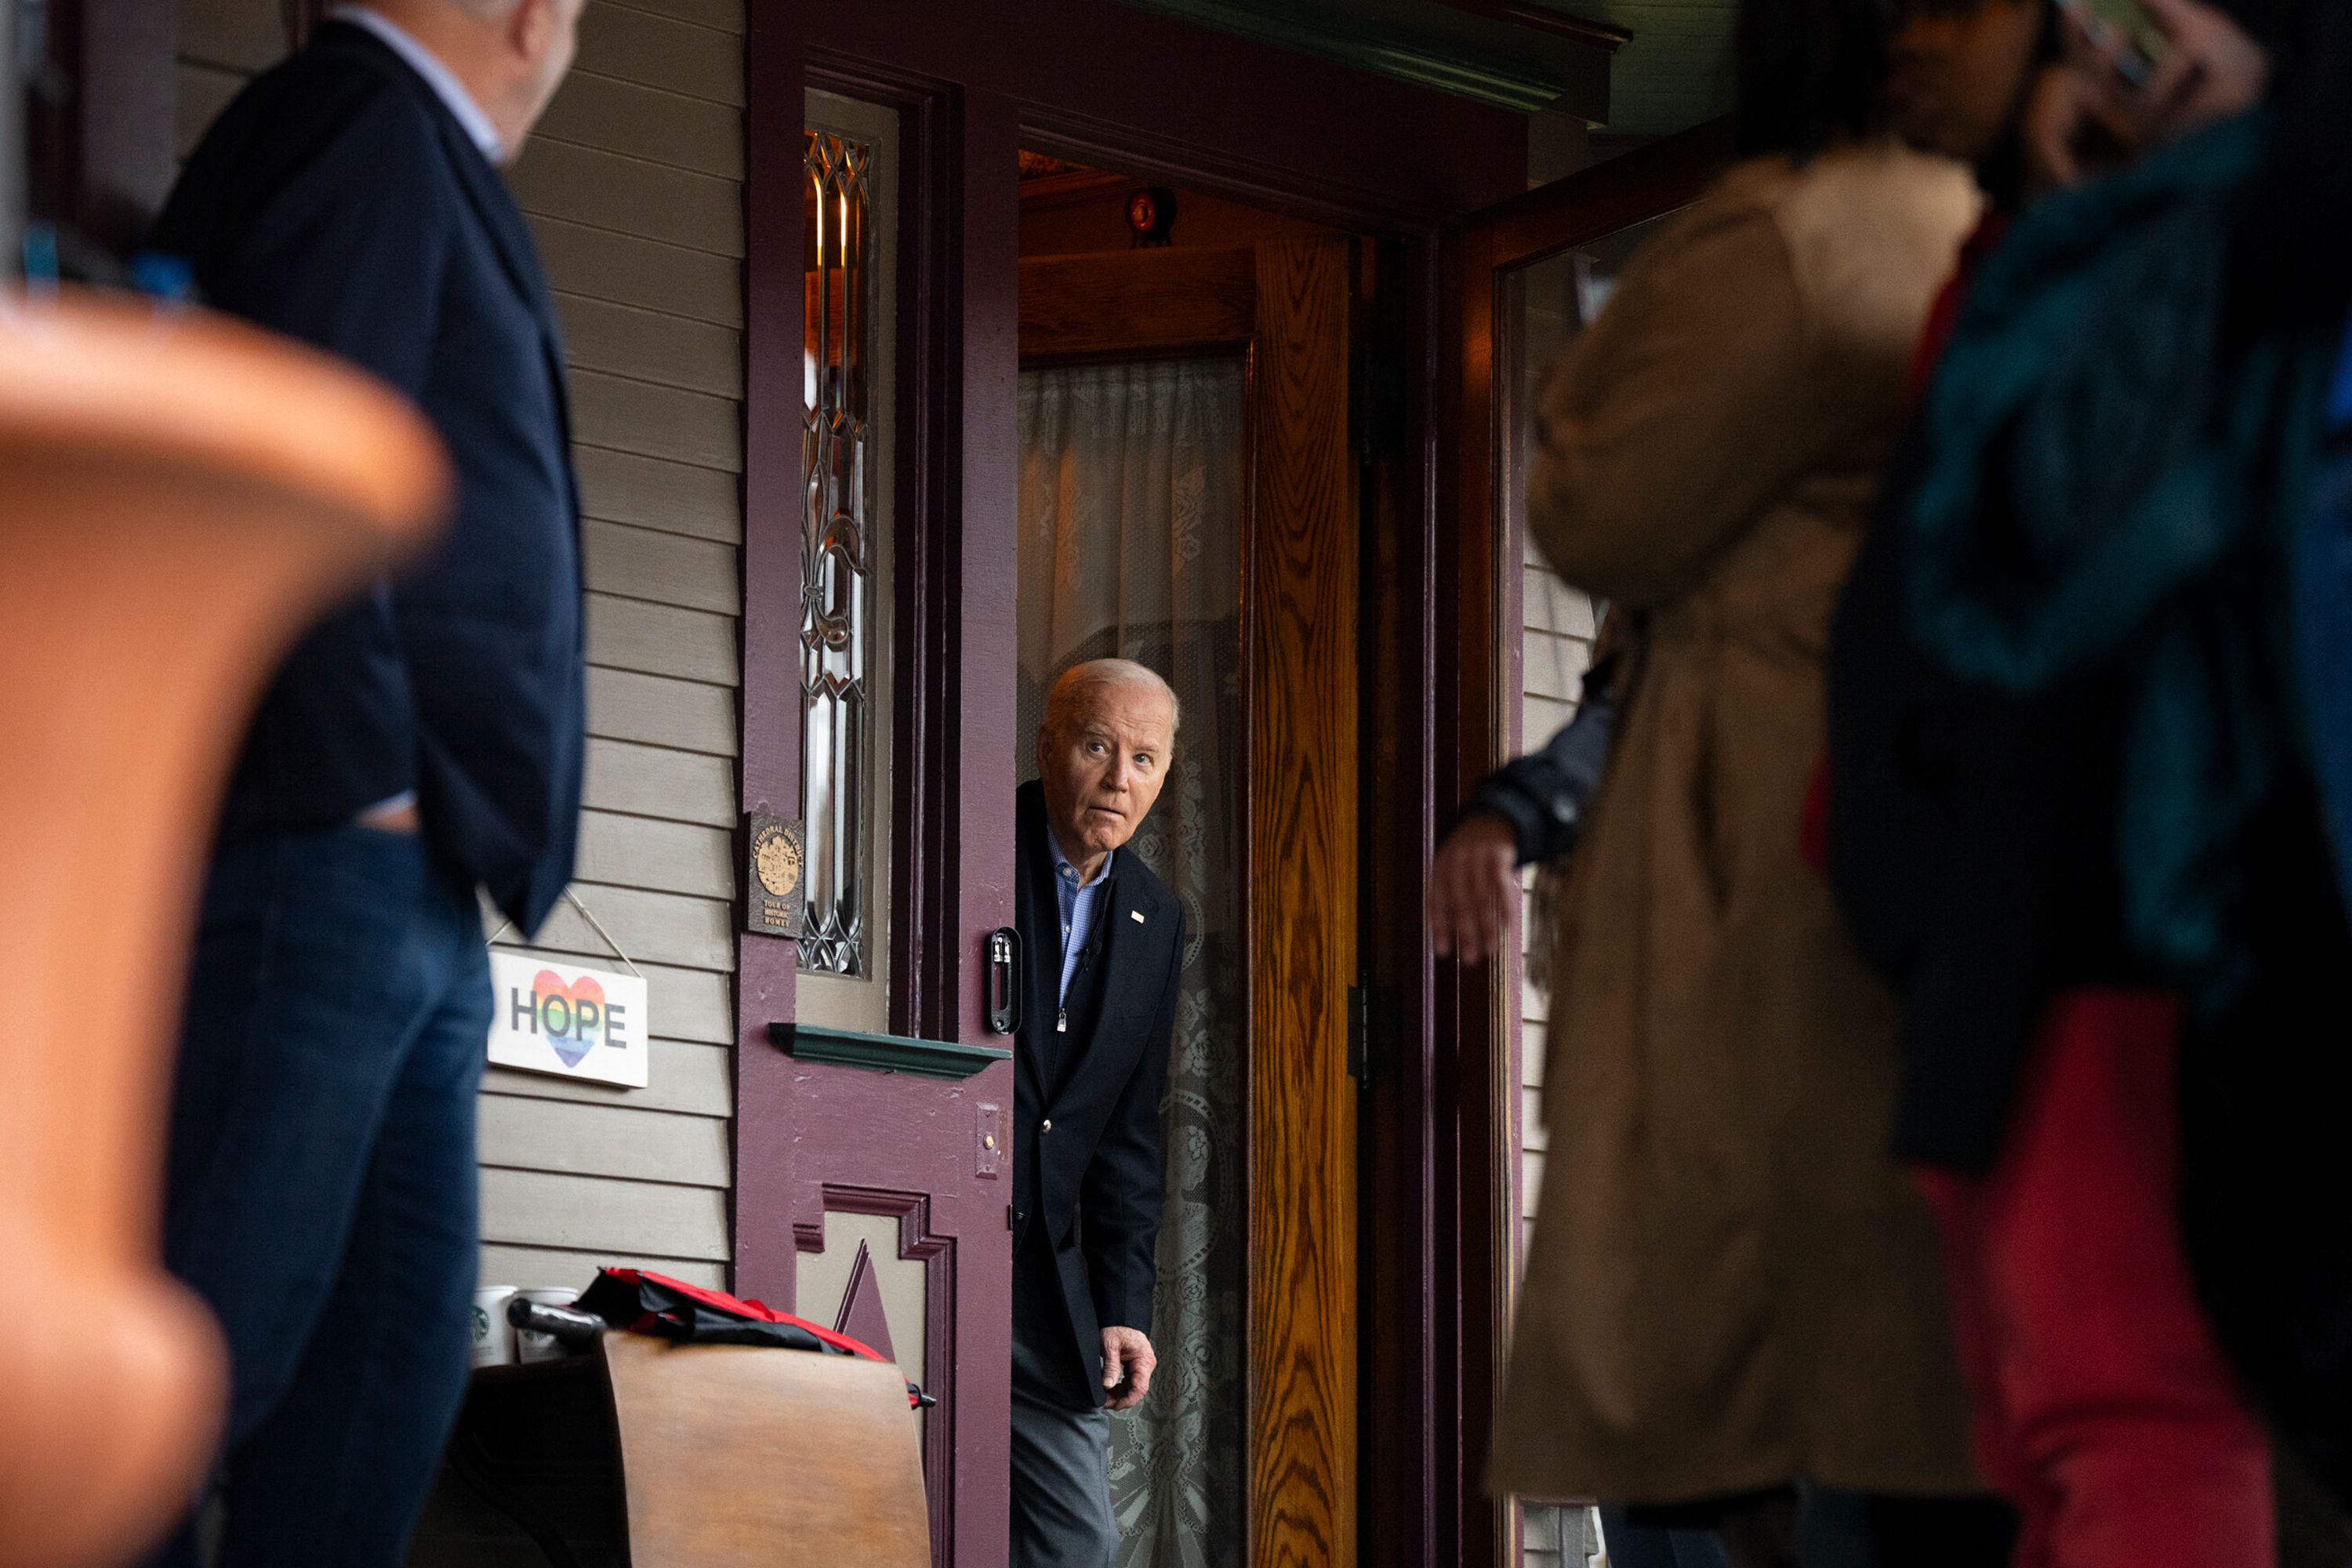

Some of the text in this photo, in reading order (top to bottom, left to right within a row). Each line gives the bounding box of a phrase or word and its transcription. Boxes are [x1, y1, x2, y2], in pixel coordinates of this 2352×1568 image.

[753, 825, 804, 867] CATHEDRAL DISTRICT
[764, 899, 781, 909] TOUR
[764, 909, 789, 919] HISTORIC
[764, 917, 790, 927] HOMES
[511, 987, 626, 1049] HOPE
